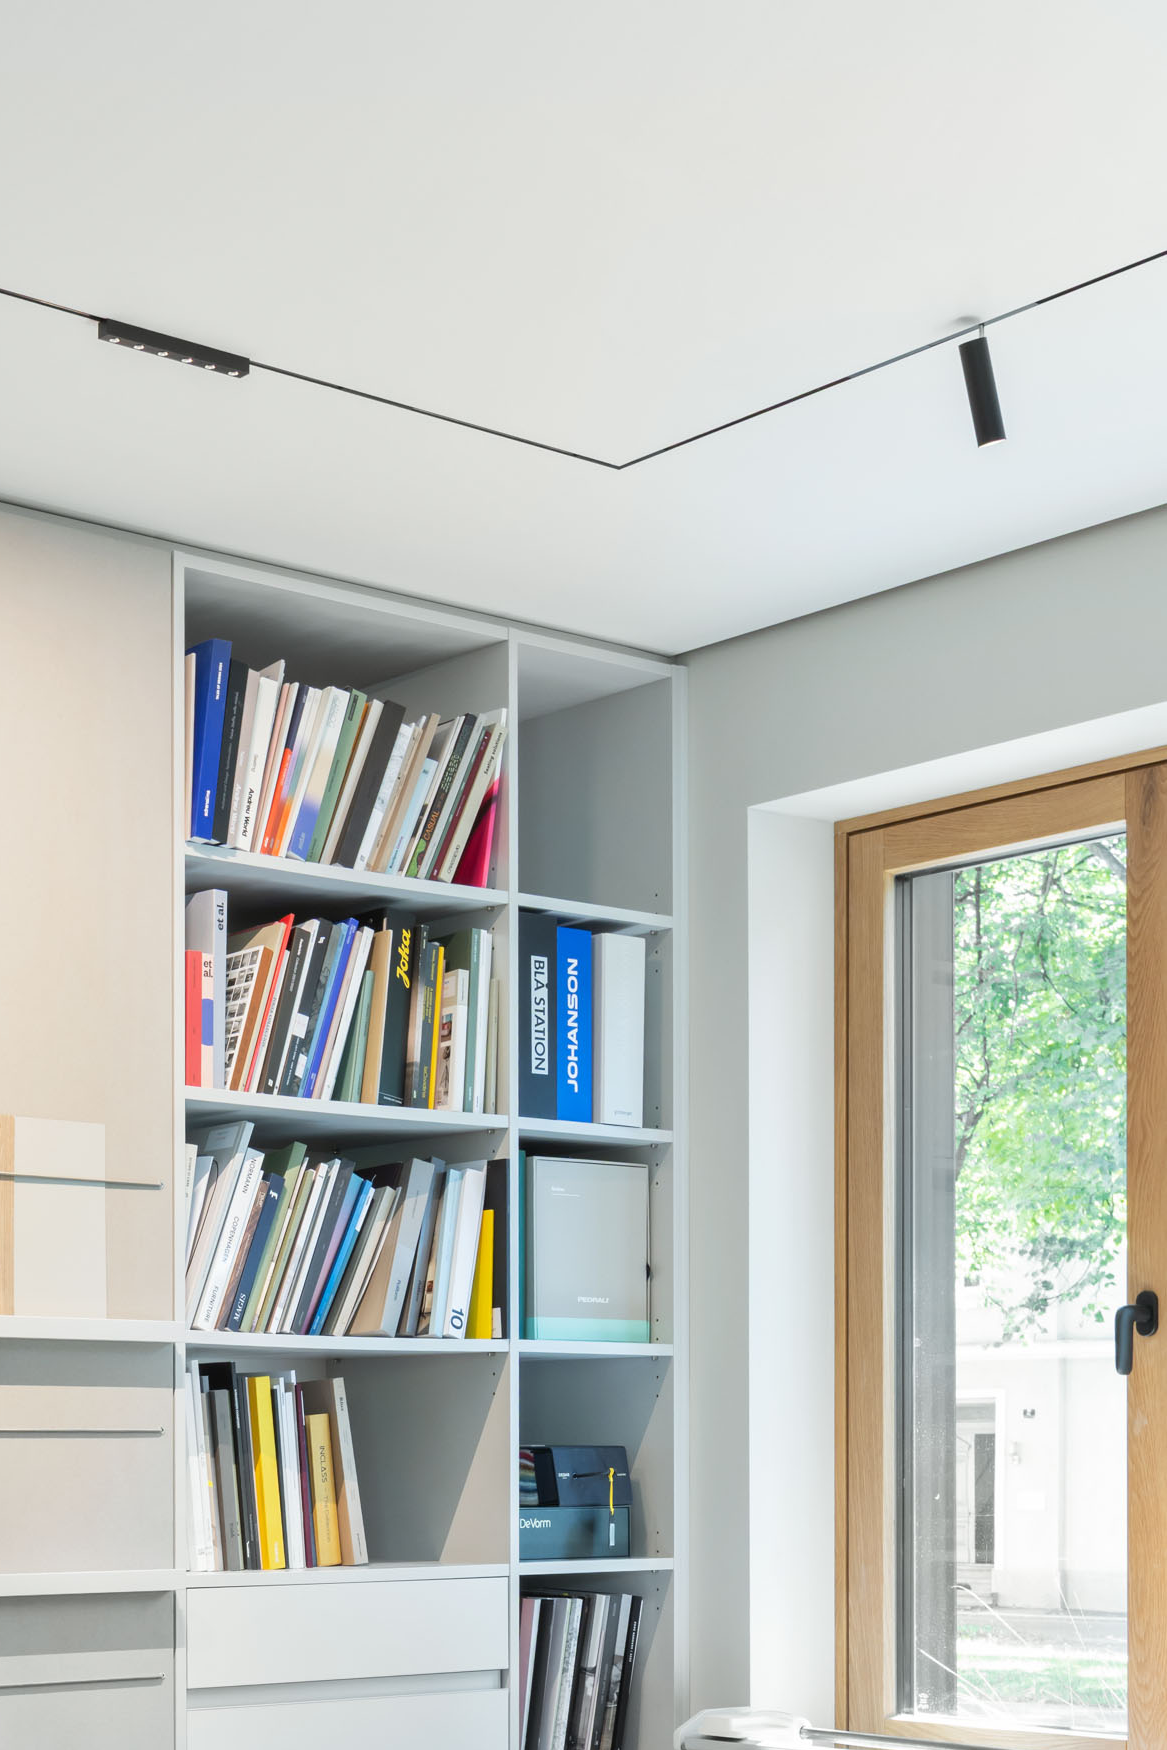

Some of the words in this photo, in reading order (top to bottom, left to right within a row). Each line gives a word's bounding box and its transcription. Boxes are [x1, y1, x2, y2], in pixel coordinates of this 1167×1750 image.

[424, 810, 439, 841] CASUAL
[203, 969, 213, 978] al.
[396, 928, 412, 989] Joka
[535, 996, 546, 1071] STATION
[567, 957, 579, 1093] JOHANSON
[241, 1157, 257, 1195] NORMANN
[222, 1216, 240, 1264] COPENHAGEN
[204, 1285, 219, 1323] FURNITURE
[233, 1293, 247, 1322] MAGIS
[450, 1307, 464, 1330] 10
[319, 1445, 328, 1484] INCLASS
[519, 1517, 552, 1530] DeVorm
